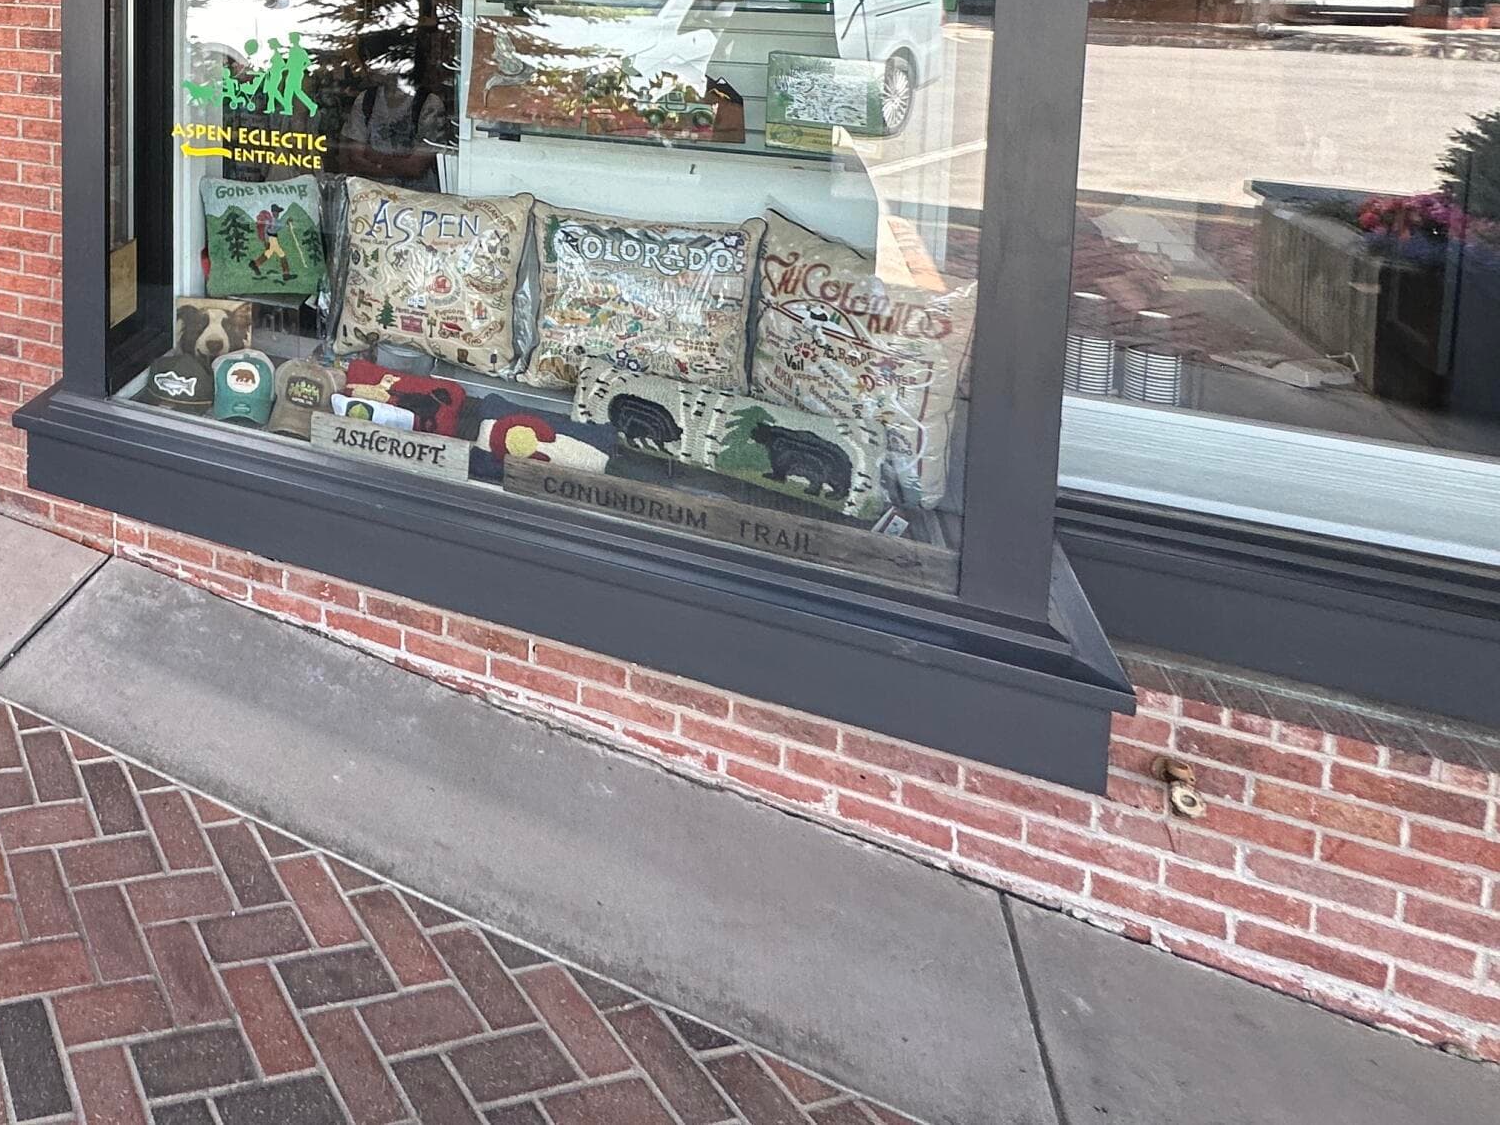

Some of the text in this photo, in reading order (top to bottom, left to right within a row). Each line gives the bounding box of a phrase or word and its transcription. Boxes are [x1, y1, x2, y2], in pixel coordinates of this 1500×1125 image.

[171, 122, 328, 153] ASPEN ECLECTIC
[234, 147, 322, 170] ENTRANCE
[365, 198, 481, 247] ASPEN
[553, 225, 736, 276] COLORADO
[333, 426, 446, 465] ASHCROFT
[543, 476, 820, 556] CONUNDRUM TRAIL
